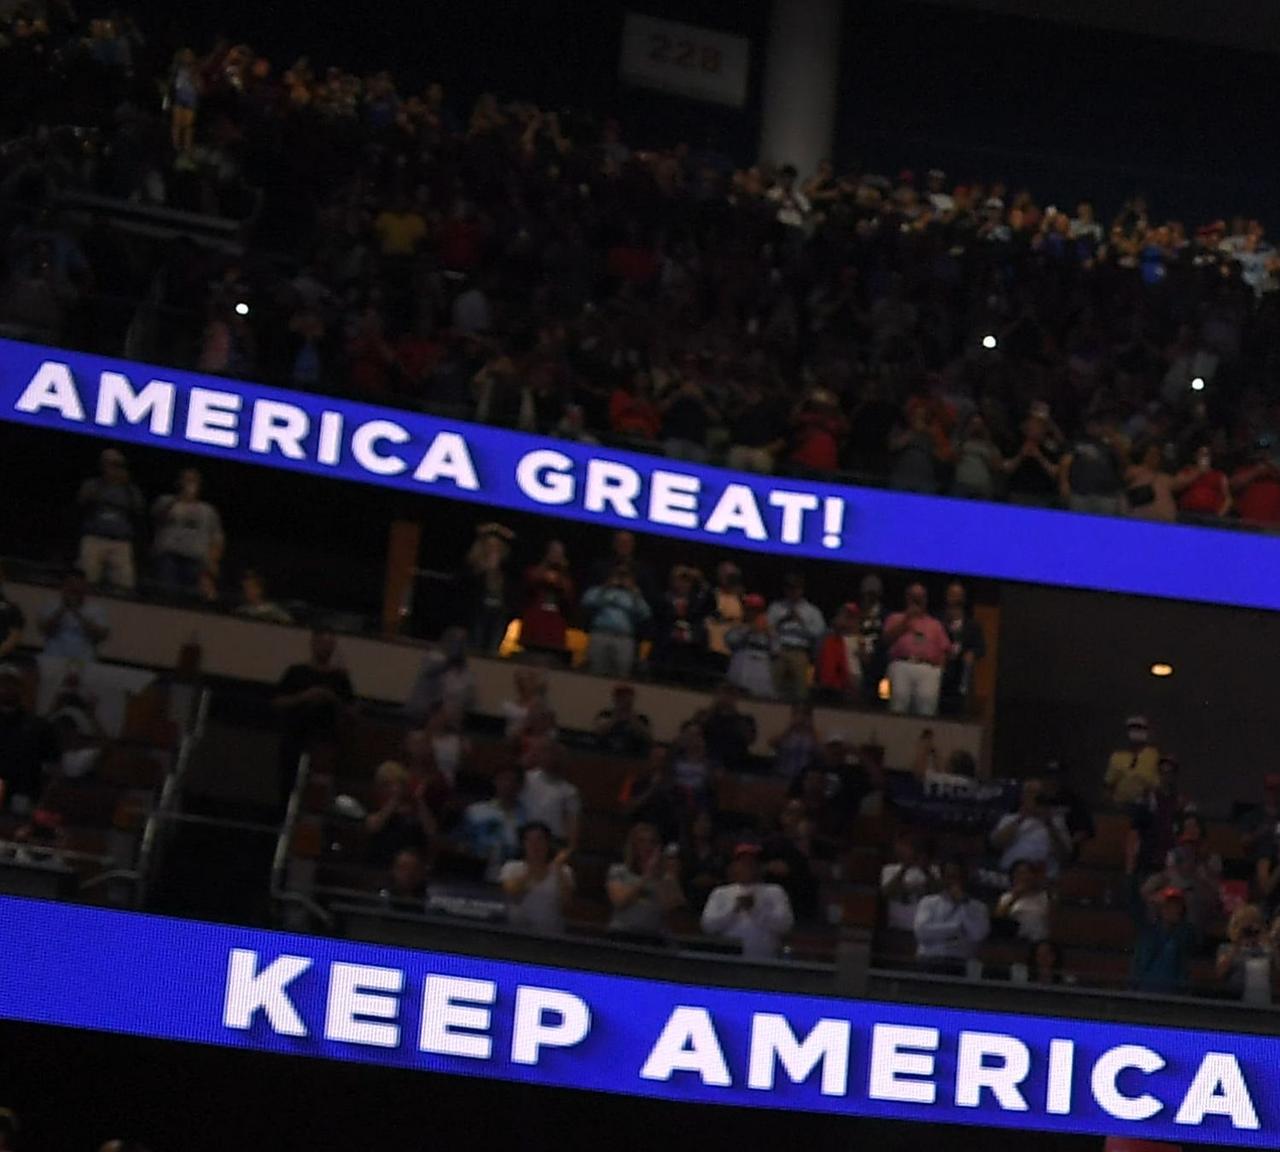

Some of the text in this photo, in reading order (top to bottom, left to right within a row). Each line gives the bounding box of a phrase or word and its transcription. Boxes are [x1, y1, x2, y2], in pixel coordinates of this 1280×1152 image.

[14, 361, 844, 549] AMERICA GREAT!
[223, 948, 592, 1064] KEEP
[641, 1006, 1260, 1129] AMERICA
